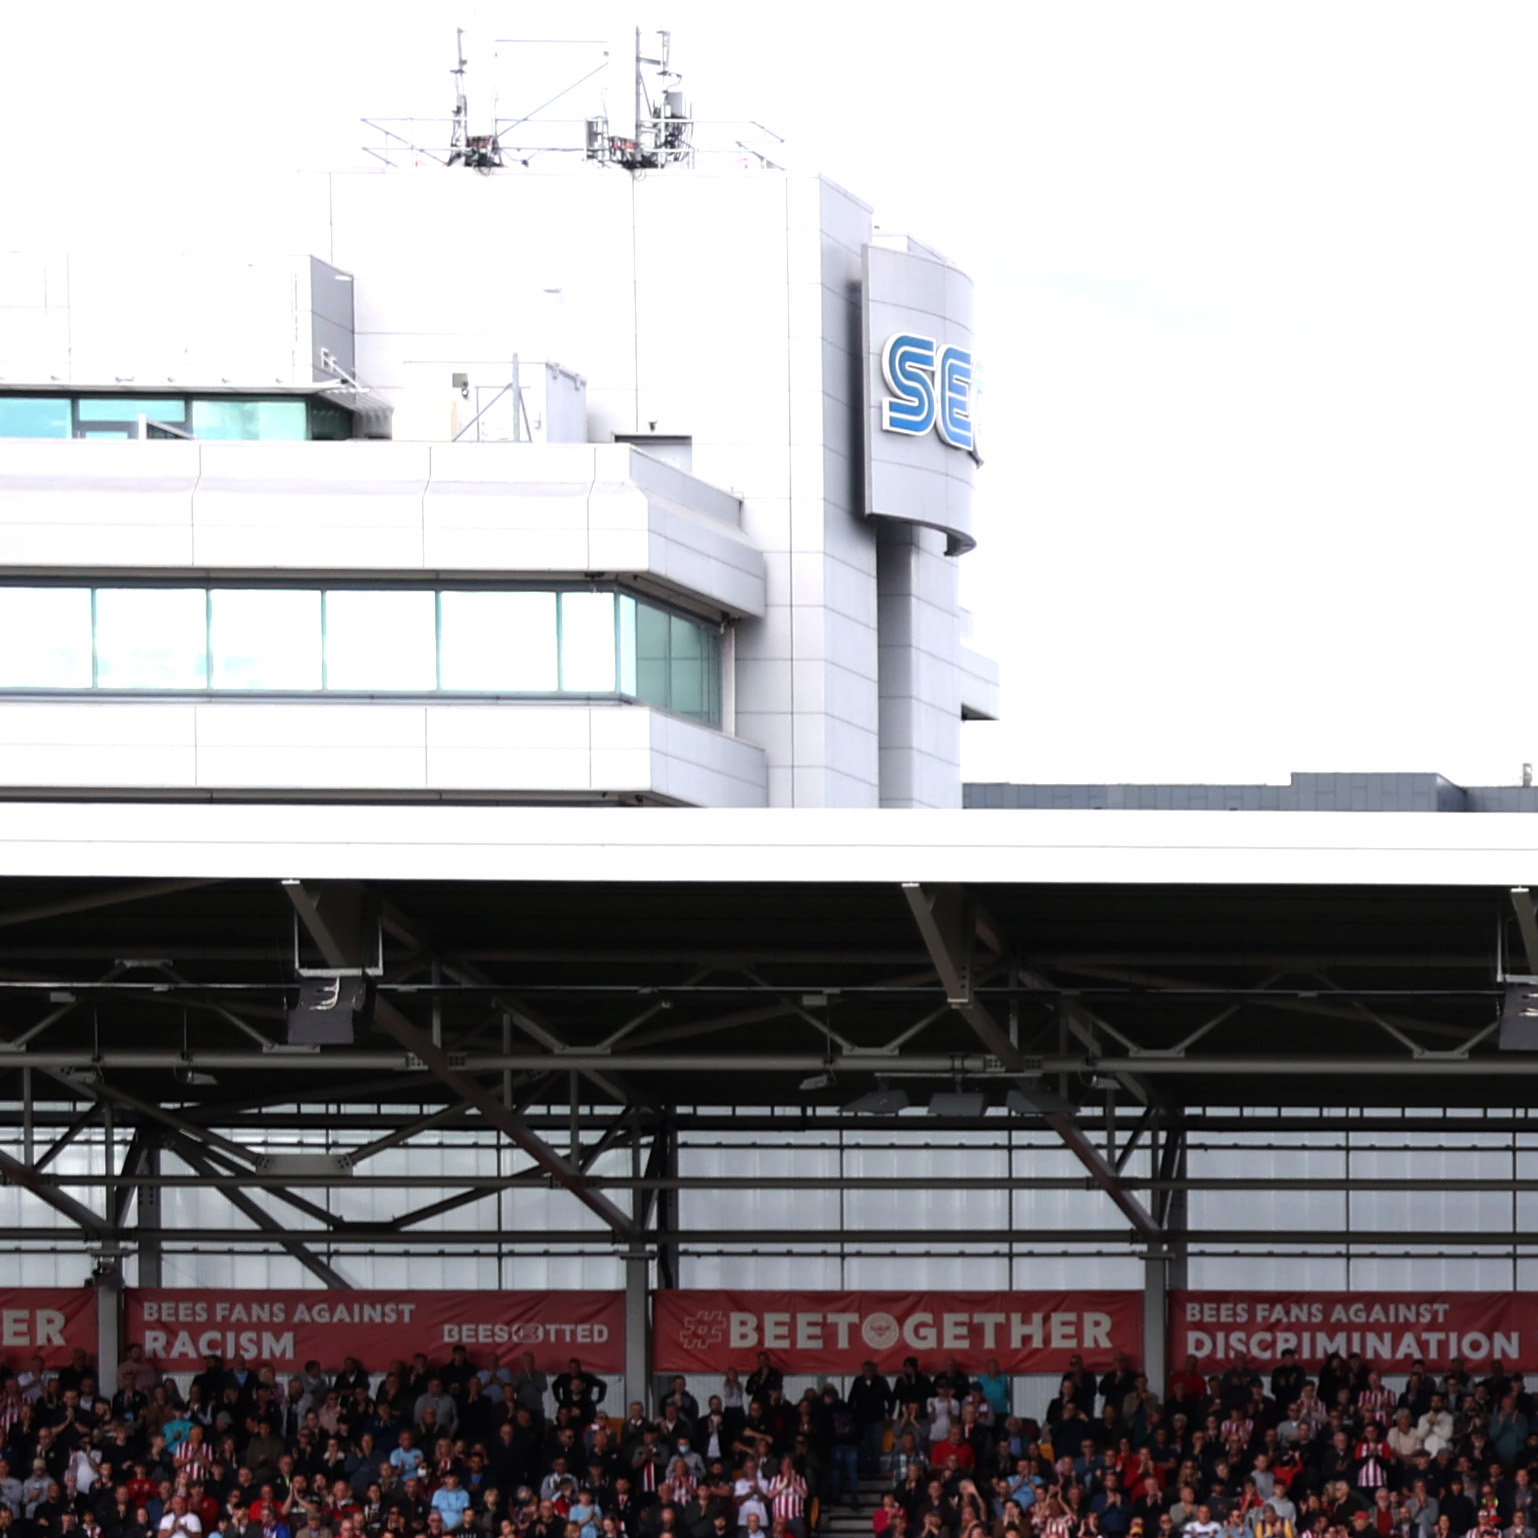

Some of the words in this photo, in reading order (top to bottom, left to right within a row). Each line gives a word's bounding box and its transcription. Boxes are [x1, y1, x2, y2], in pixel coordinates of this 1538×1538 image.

[144, 1303, 208, 1322] BEES
[216, 1303, 285, 1323] FANS
[293, 1303, 416, 1323] AGAINST
[1185, 1304, 1249, 1323] BEES
[1256, 1304, 1323, 1323] FANS
[1330, 1304, 1449, 1323] AGAINST
[144, 1331, 295, 1360] RACISM
[1186, 1331, 1520, 1360] DISCRIMINATION
